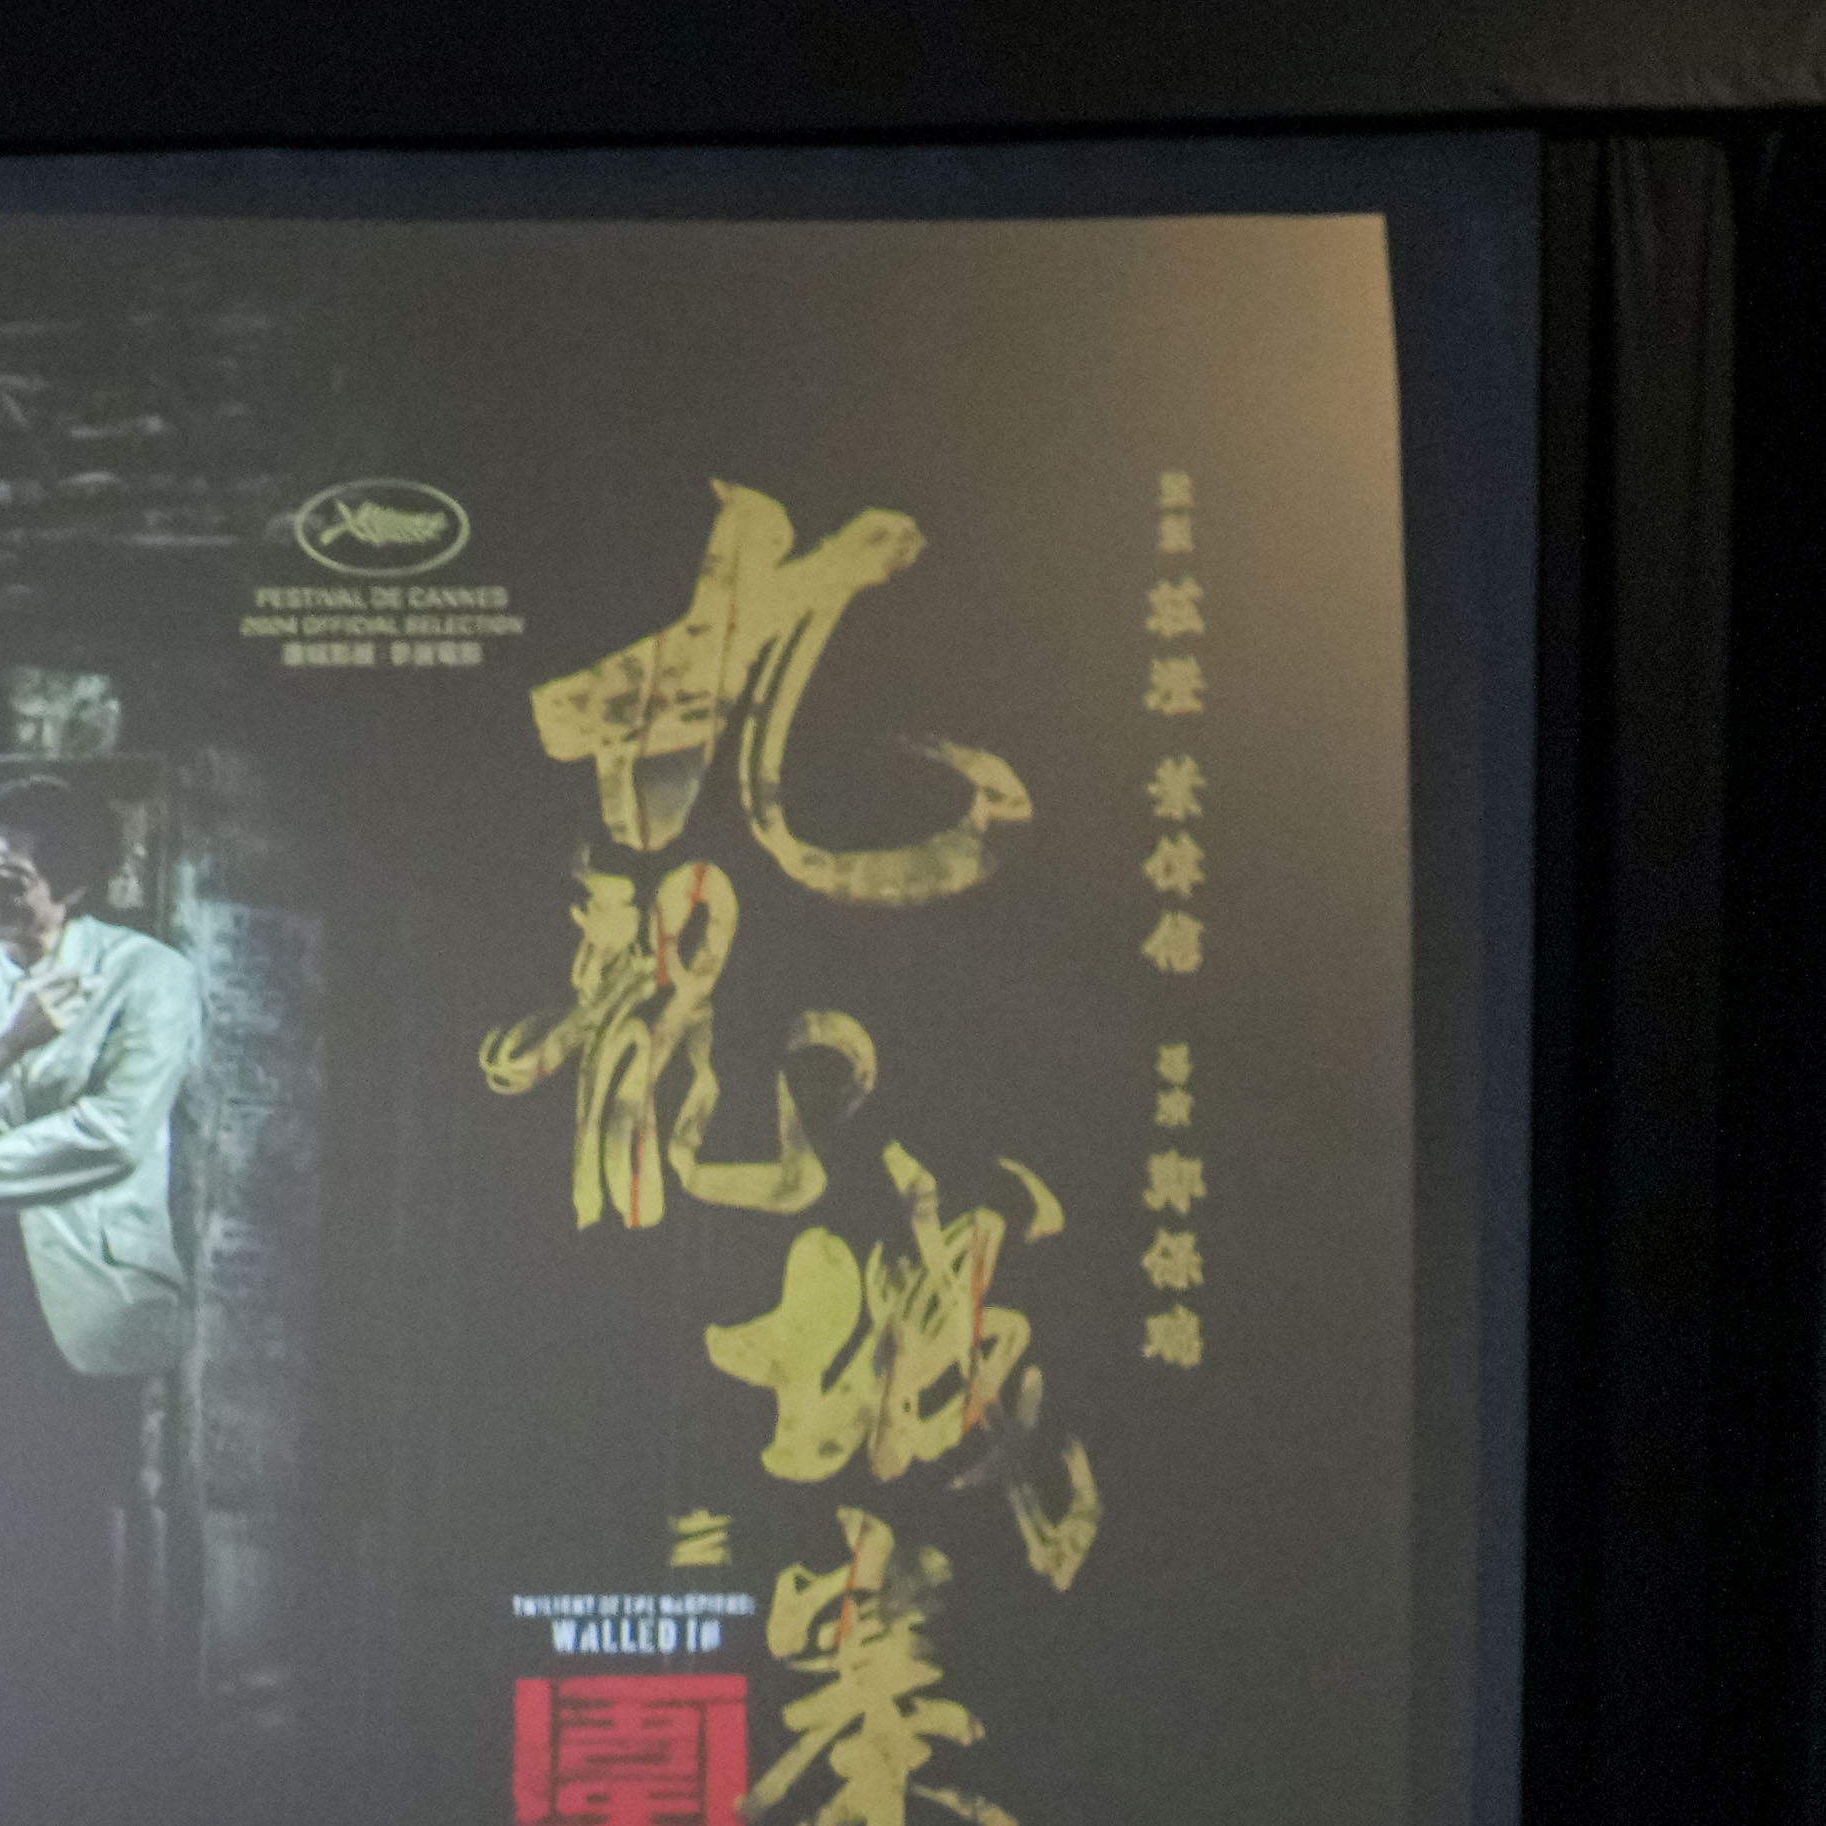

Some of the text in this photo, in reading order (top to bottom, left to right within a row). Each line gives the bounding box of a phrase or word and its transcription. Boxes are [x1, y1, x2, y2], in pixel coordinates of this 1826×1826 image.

[407, 585, 509, 609] CANNES
[552, 1617, 724, 1654] WALLED IN
